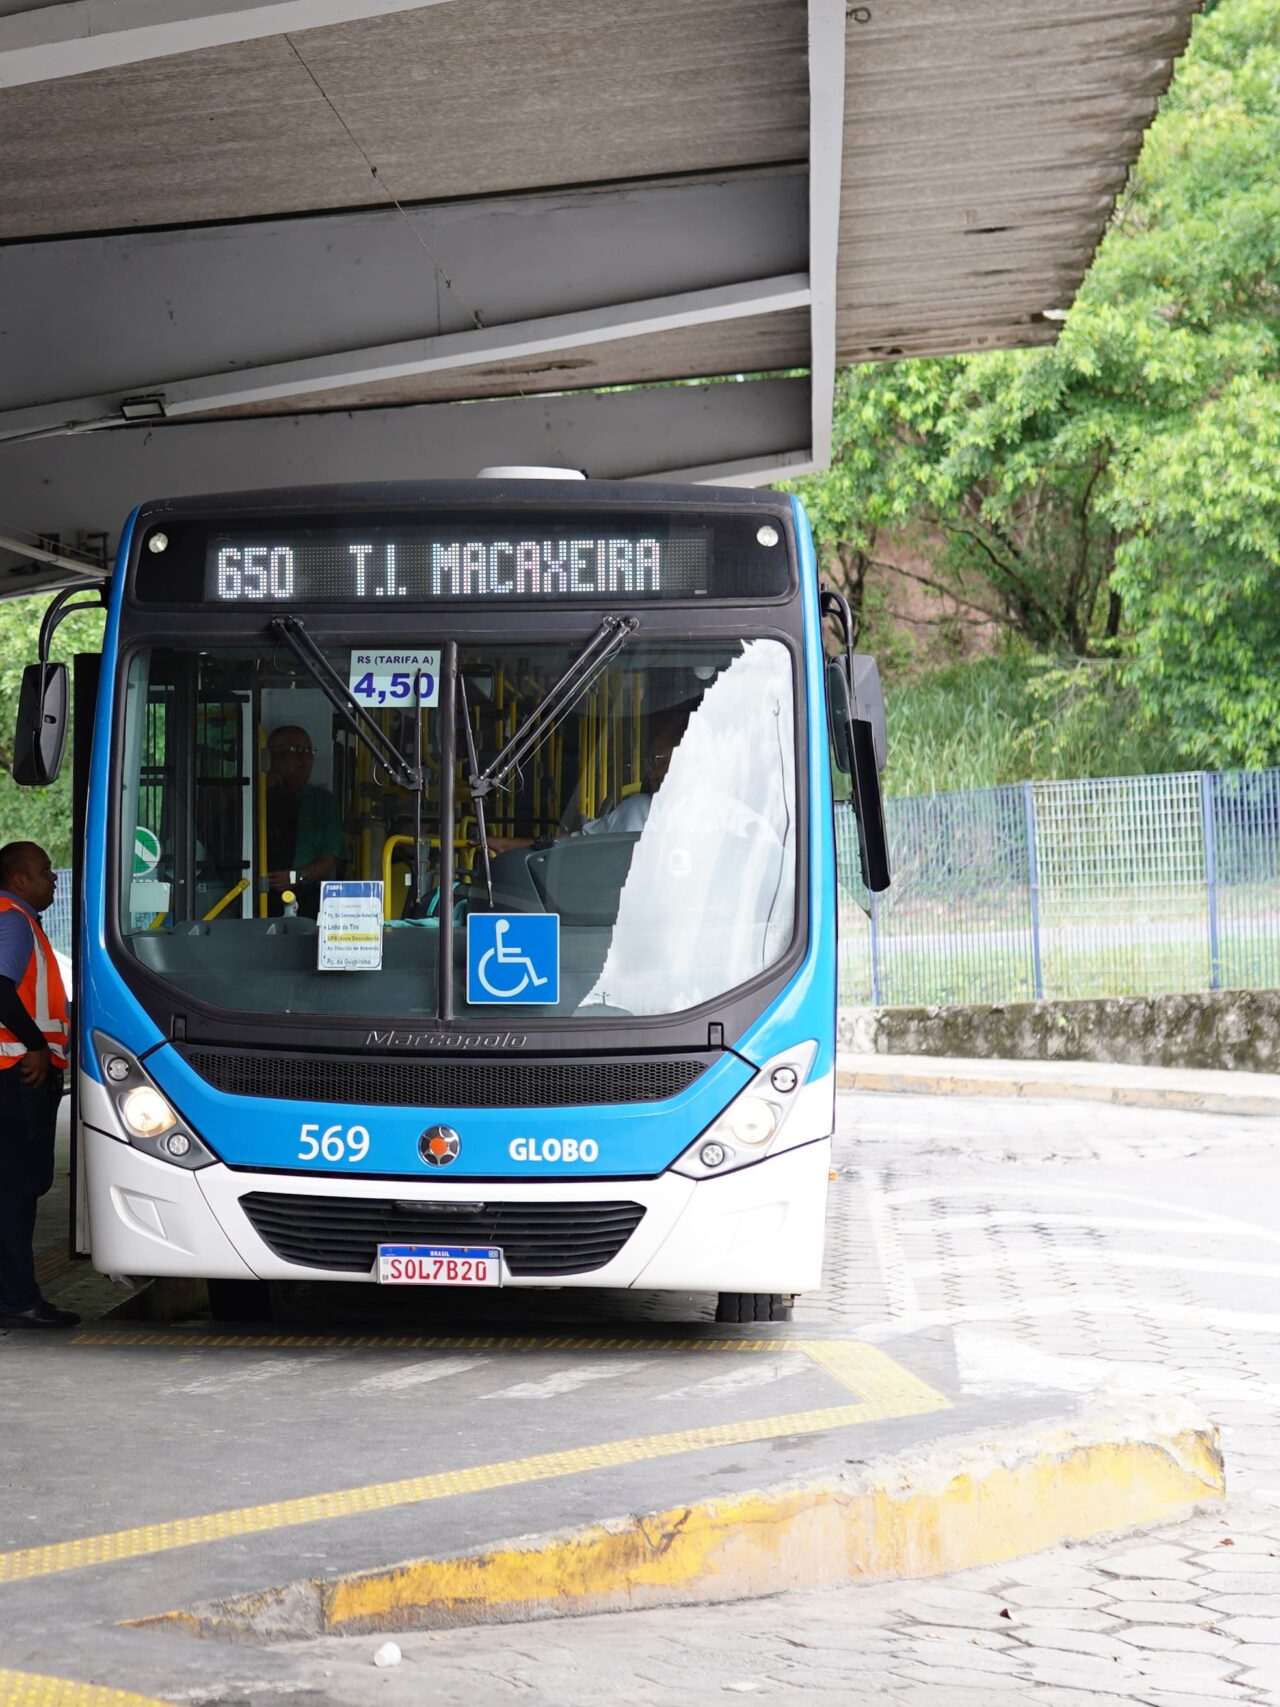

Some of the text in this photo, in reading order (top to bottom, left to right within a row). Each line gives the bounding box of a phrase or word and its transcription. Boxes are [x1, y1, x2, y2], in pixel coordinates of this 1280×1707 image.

[219, 539, 660, 598] 650 T.I. MACAXEIRA
[357, 655, 434, 666] R$ (TARIFA A)
[353, 672, 435, 705] 4,50
[365, 1030, 528, 1049] Marcopolo
[297, 1124, 599, 1162] 569 GLOBO
[390, 1258, 487, 1281] SOL7B20
